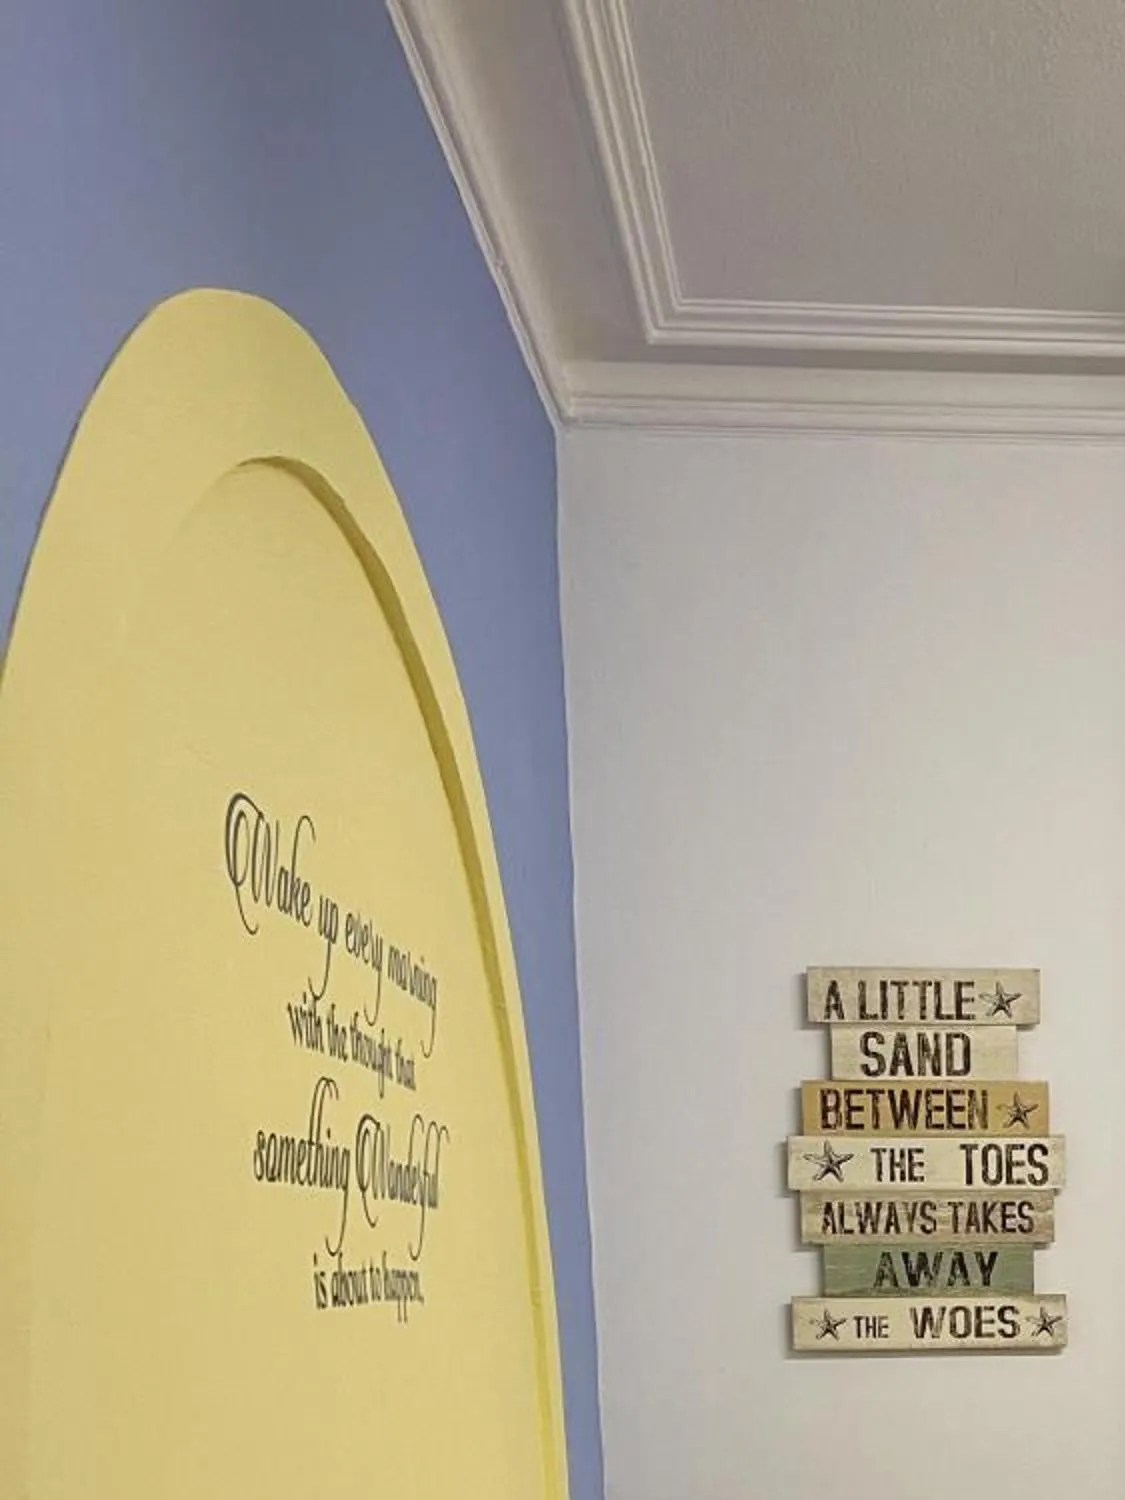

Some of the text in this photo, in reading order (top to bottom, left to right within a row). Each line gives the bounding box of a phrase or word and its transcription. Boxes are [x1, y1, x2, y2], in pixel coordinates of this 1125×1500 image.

[225, 793, 437, 1058] Wake up every morning
[823, 980, 976, 1020] A LITTLE
[287, 990, 417, 1099] with the thought that
[860, 1031, 972, 1077] SAND
[820, 1088, 989, 1131] BETWEEN
[254, 1076, 450, 1260] something Wonderful
[871, 1143, 1049, 1187] THE TOES
[822, 1201, 1034, 1235] ALWAYS TAKES
[314, 1252, 328, 1309] is
[332, 1252, 368, 1307] about
[369, 1257, 381, 1301] to
[873, 1251, 999, 1288] AWAY
[854, 1305, 1021, 1340] THE WOES
